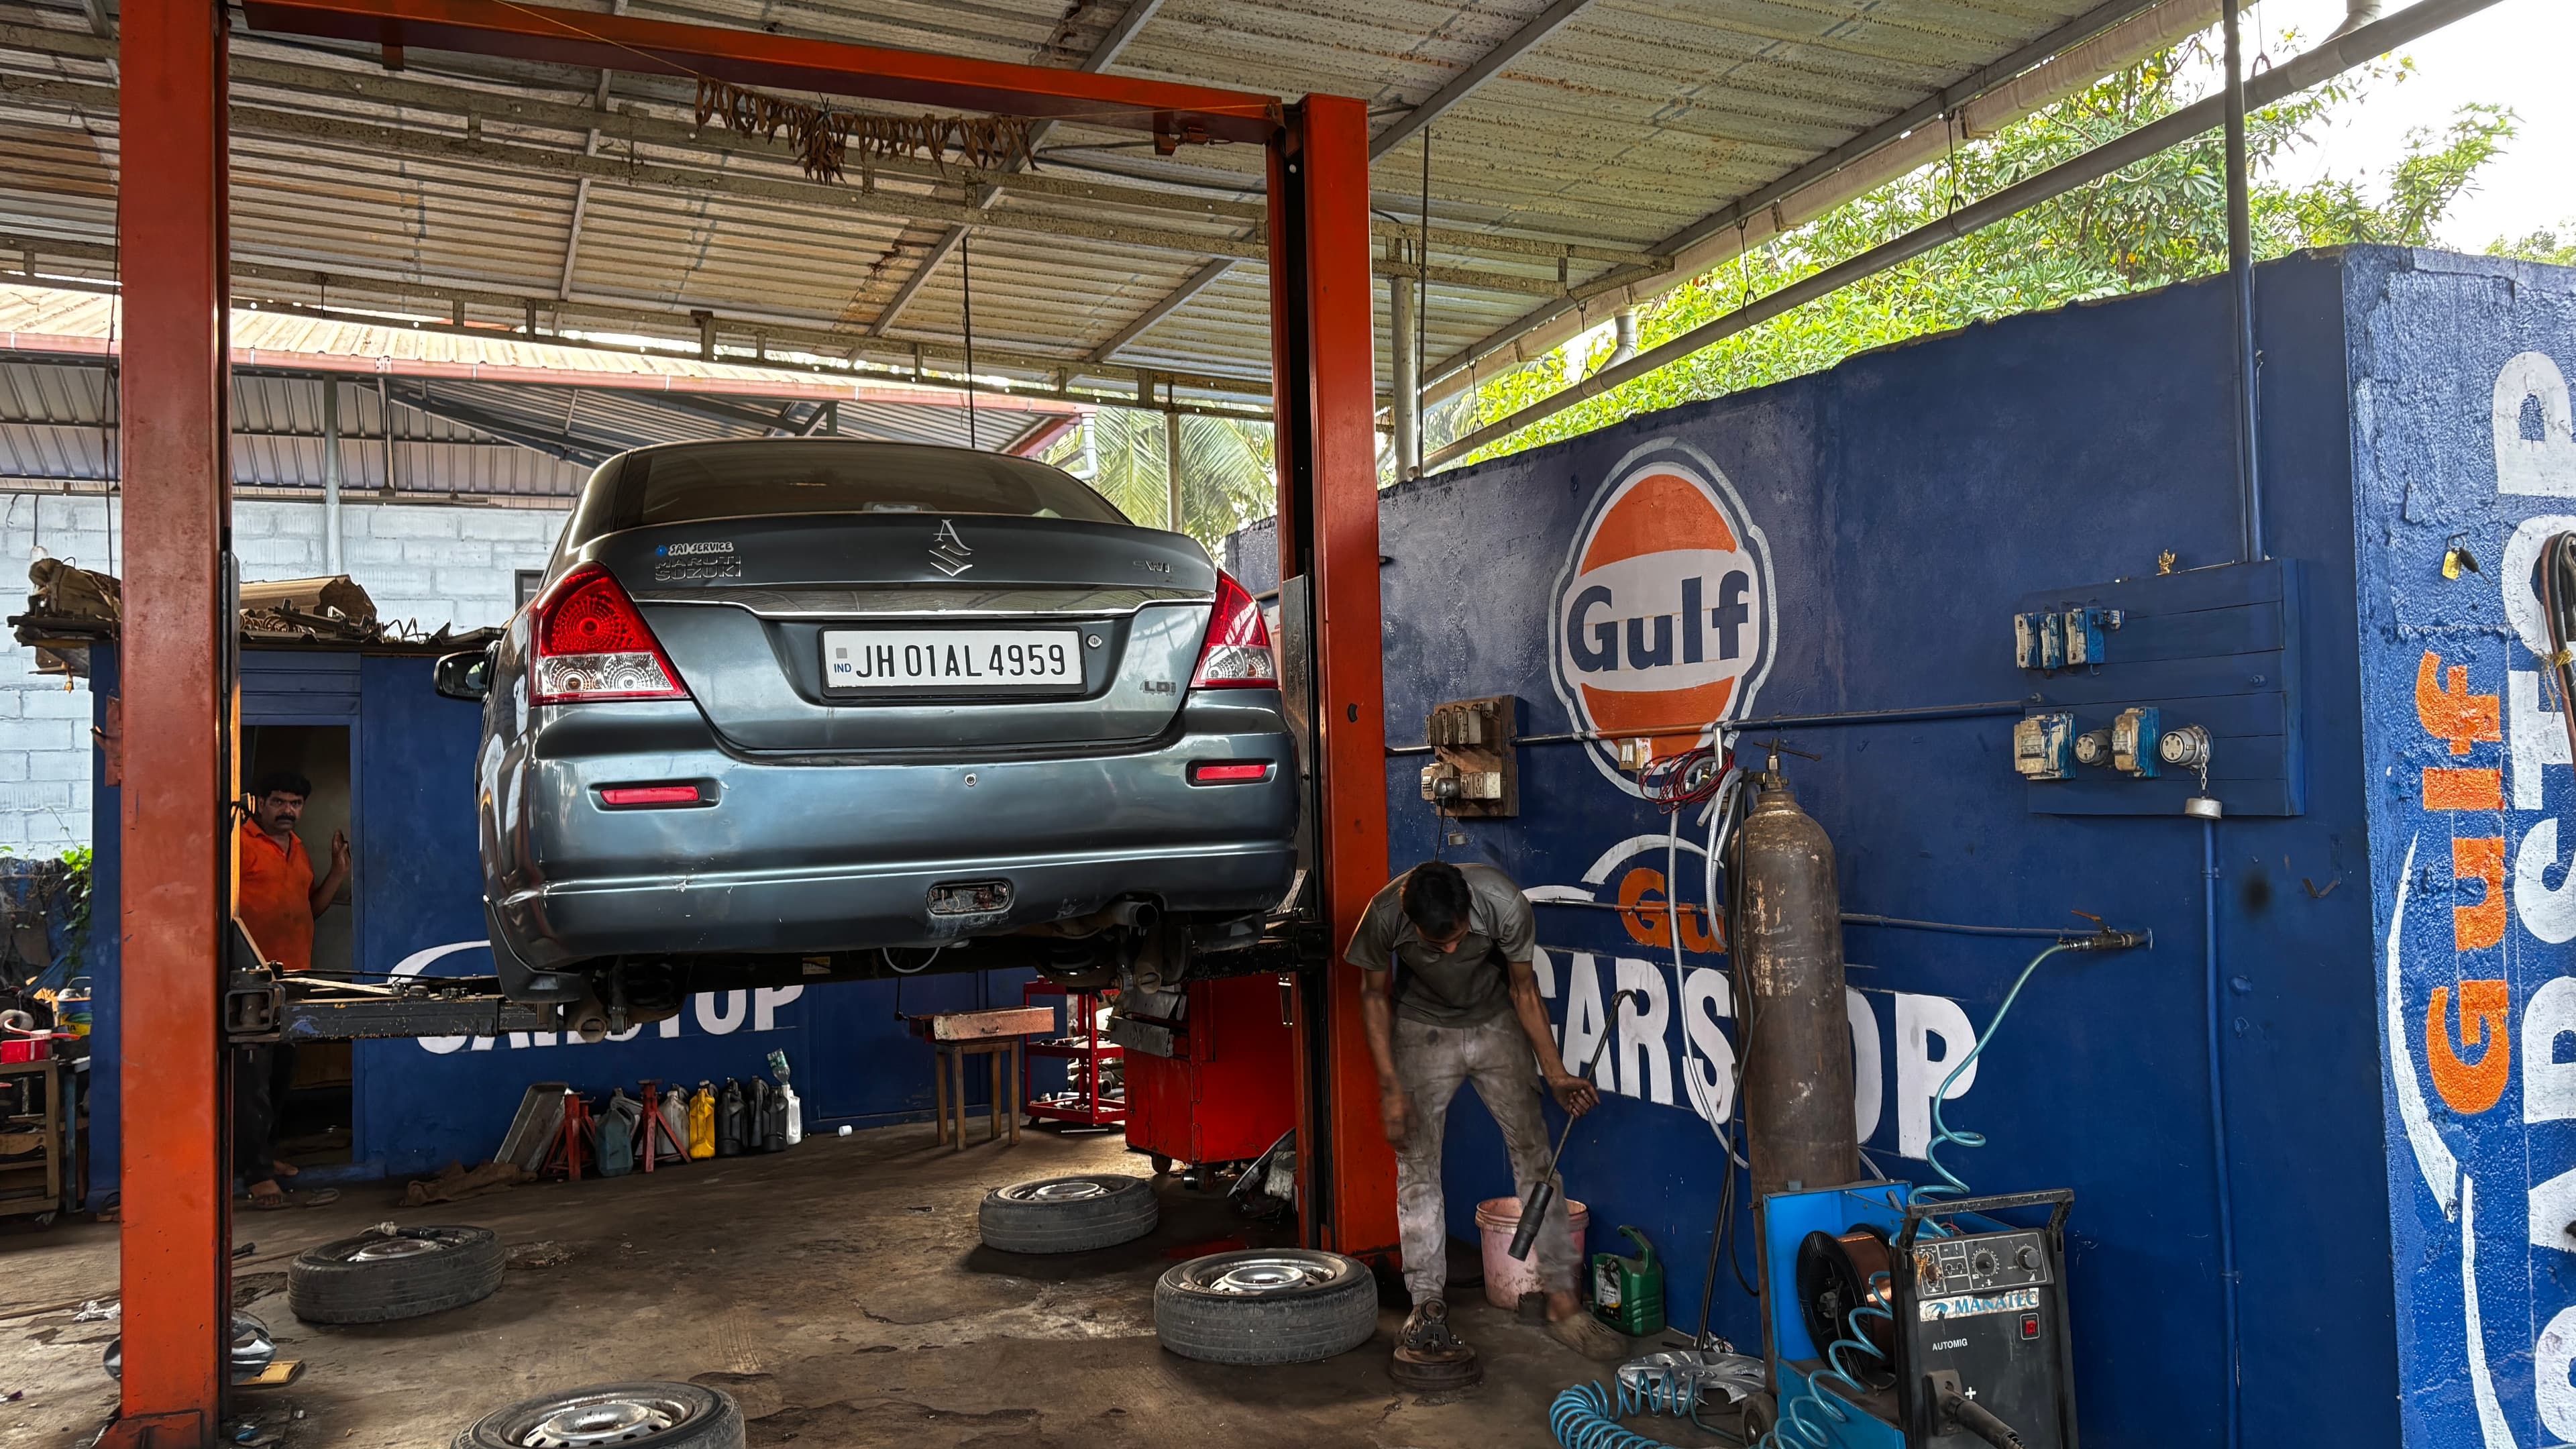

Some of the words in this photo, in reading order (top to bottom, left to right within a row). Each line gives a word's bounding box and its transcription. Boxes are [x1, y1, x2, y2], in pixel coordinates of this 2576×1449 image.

[668, 543, 689, 555] SAI
[691, 542, 734, 554] SERVICE
[655, 556, 741, 570] MARUTI
[655, 566, 741, 581] SUZUKI
[1566, 570, 1750, 673] Gulf
[834, 663, 852, 674] IND
[2416, 652, 2510, 1114] Gulf
[1955, 1291, 2039, 1314] MANATEC
[1932, 1338, 1968, 1352] AUTOMIG
